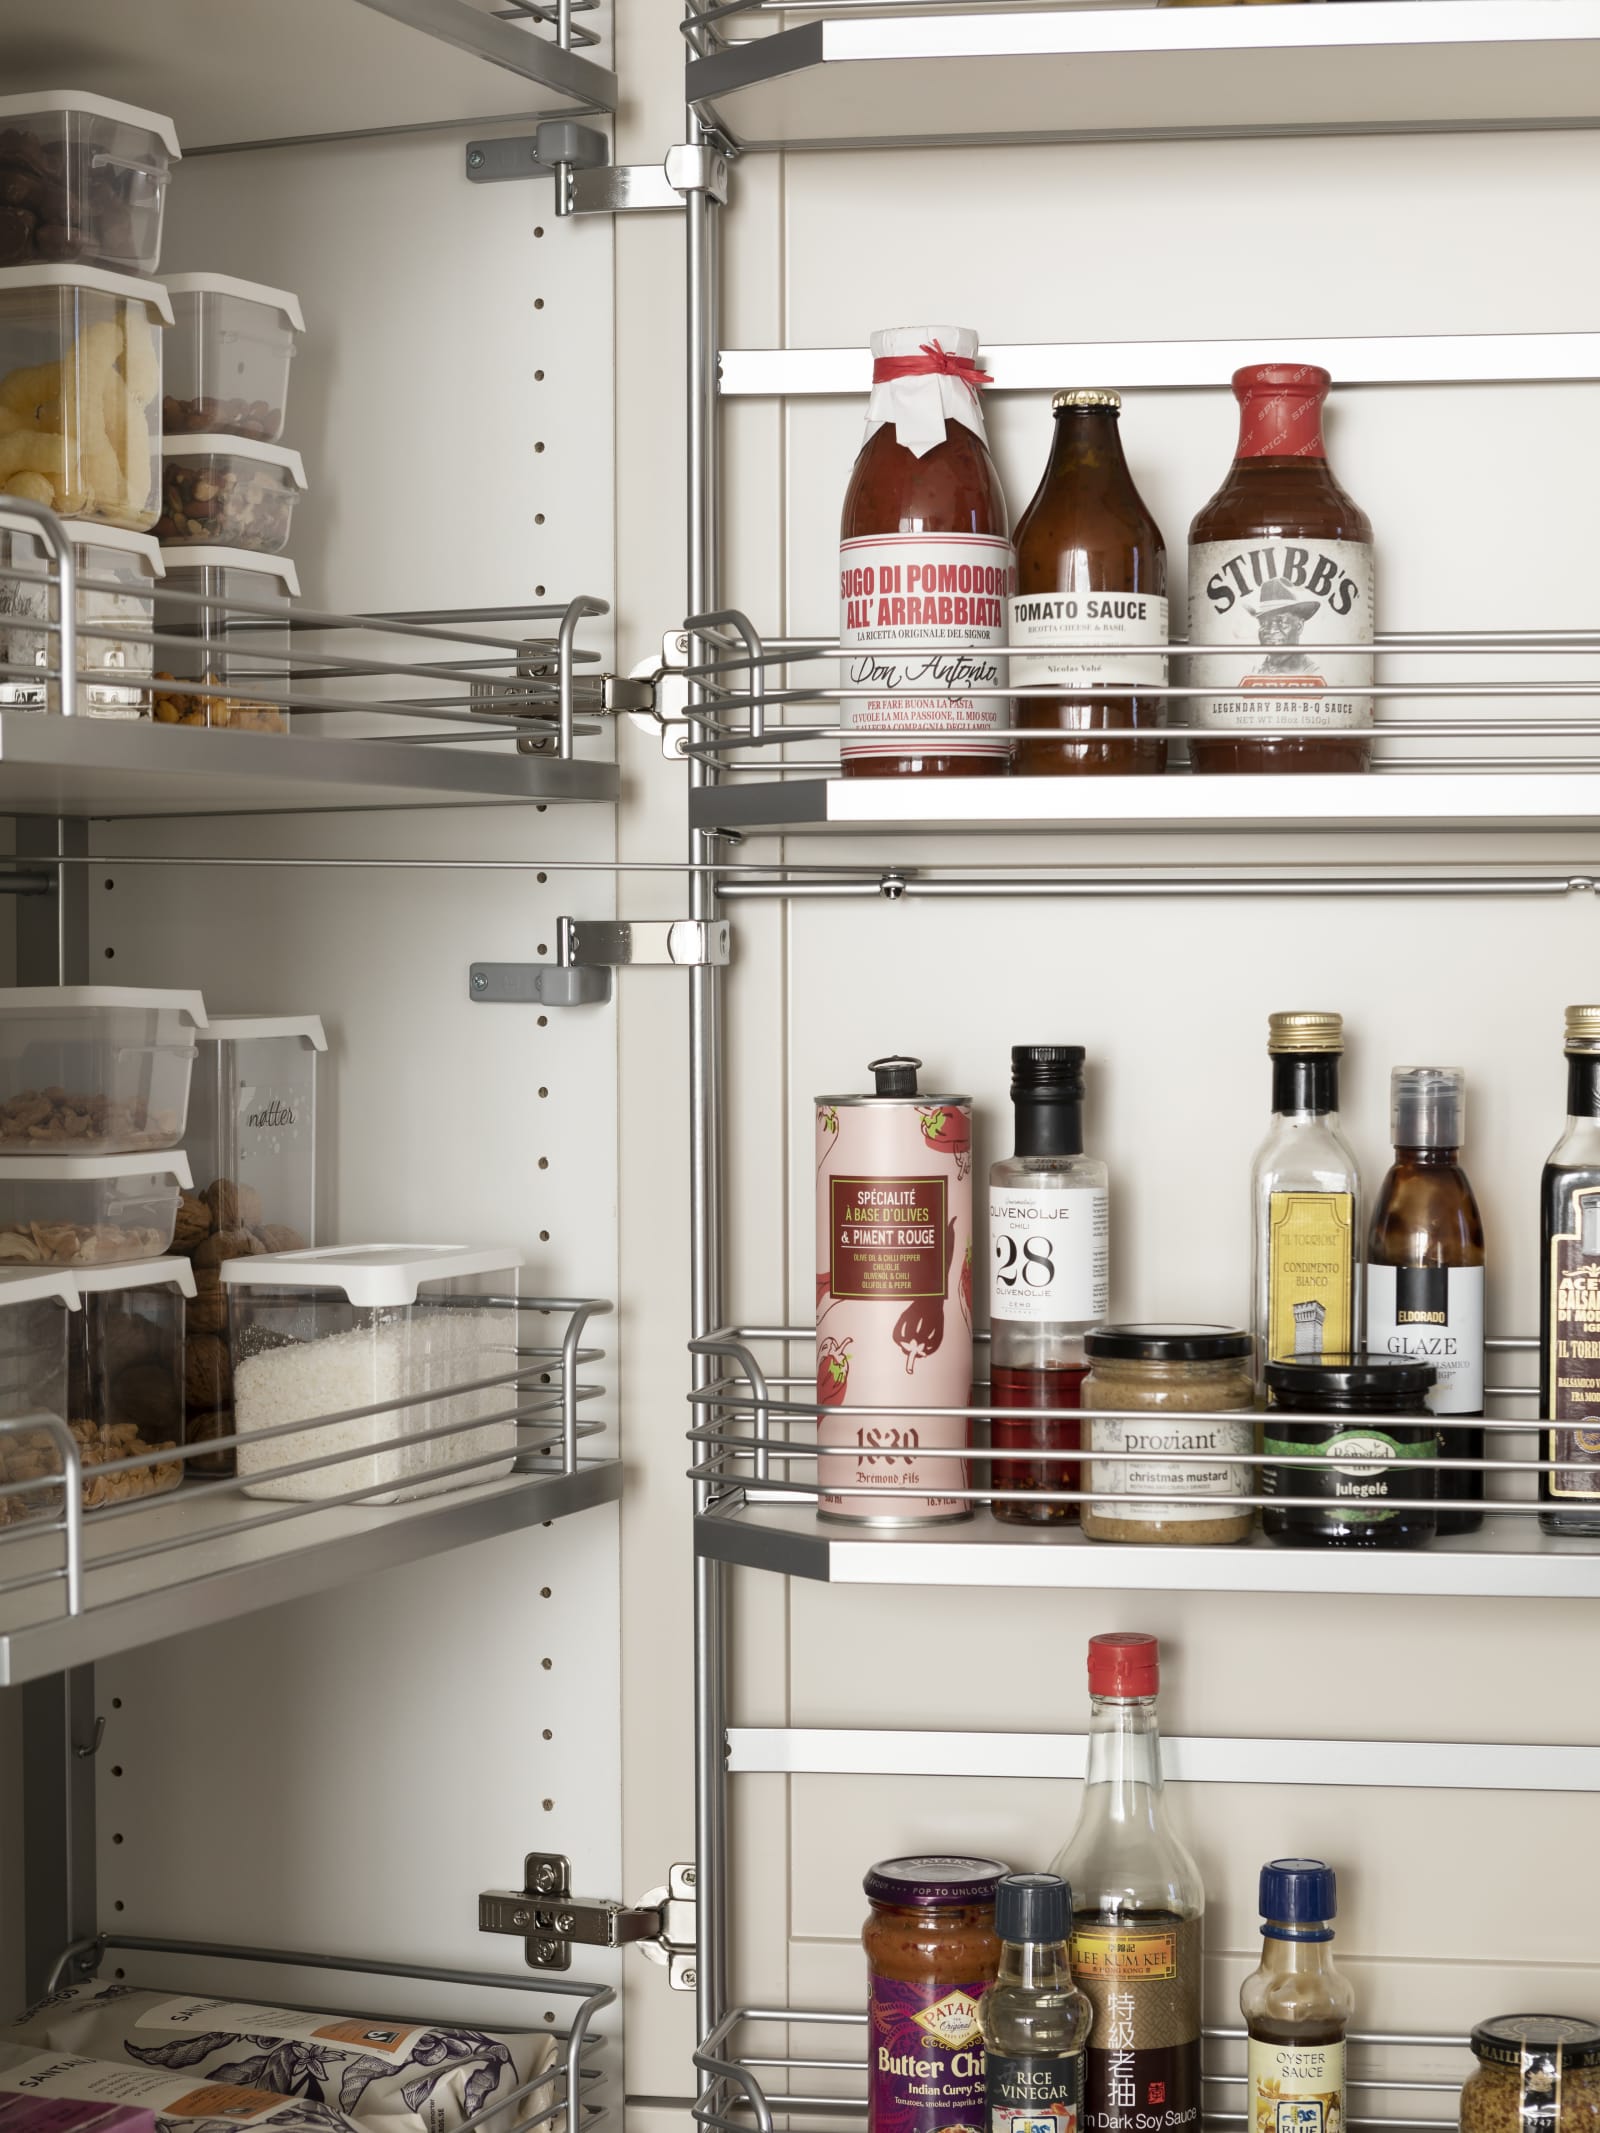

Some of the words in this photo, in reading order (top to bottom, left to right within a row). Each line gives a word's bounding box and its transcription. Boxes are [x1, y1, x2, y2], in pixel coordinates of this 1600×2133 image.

[1258, 389, 1288, 421] SPICY
[1291, 392, 1323, 421] SPICY
[841, 566, 875, 600] SUGO
[879, 564, 901, 595] DI
[906, 563, 1008, 598] POMODORO
[1206, 546, 1360, 616] STUBB'S
[847, 598, 874, 629] ALL'
[877, 596, 1002, 627] ARRABBIATA
[1014, 600, 1078, 623] TOMATO
[1086, 600, 1147, 620] SAUCE
[857, 631, 866, 641] LA
[866, 630, 897, 641] RICETTA
[898, 628, 946, 639] ORIGINALE
[947, 629, 963, 639] DEL
[964, 629, 991, 640] SIGNOR
[850, 654, 903, 688] Don
[904, 646, 998, 692] Antonio
[867, 700, 882, 710] PER
[882, 699, 904, 710] FARE
[904, 698, 936, 709] BUONA
[936, 698, 949, 709] LA
[949, 699, 974, 709] PASTA
[1213, 703, 1271, 714] LEGENDARY
[1275, 702, 1320, 713] BAR-B-Q
[1325, 703, 1353, 714] SAUCE
[858, 712, 881, 722] VUOLE
[881, 712, 892, 721] LA
[893, 711, 911, 721] MIA
[911, 711, 955, 722] PASSIONE,
[956, 711, 965, 721] IL
[966, 711, 981, 721] MIO
[1236, 716, 1254, 725] NET
[1258, 716, 1272, 724] WT
[857, 1188, 916, 1206] SPÉCIALITÉ
[845, 1205, 852, 1221] À
[854, 1207, 880, 1222] BASE
[883, 1207, 929, 1222] D'OLIVES
[1009, 1222, 1030, 1230] CHILI
[841, 1231, 850, 1244] &
[853, 1229, 894, 1246] PIMENT
[898, 1229, 935, 1245] ROUGE
[996, 1234, 1056, 1288] 28
[1283, 1262, 1340, 1274] CONDIMENTO
[1295, 1276, 1329, 1287] BIANCO
[1559, 1277, 1600, 1290] ACE
[1397, 1310, 1446, 1324] ELDORADO
[1558, 1310, 1572, 1321] DI
[1387, 1336, 1457, 1355] GLAZE
[1558, 1340, 1569, 1358] IL
[1430, 1360, 1471, 1369] ALSAMICO
[1124, 1429, 1217, 1453] proviant
[1129, 1471, 1184, 1483] christmas
[1186, 1470, 1229, 1482] mustard
[1335, 1481, 1389, 1497] Julegelé
[913, 1887, 931, 1896] POP
[936, 1888, 949, 1896] TO
[952, 1886, 989, 1896] UNLOCK
[1076, 1951, 1099, 1965] LEE
[1104, 1953, 1140, 1967] KUM
[1143, 1952, 1168, 1966] KEE
[923, 2002, 977, 2028] PATAK
[1107, 1991, 1136, 2107] 特級老抽
[1480, 2044, 1521, 2064] MAILL
[878, 2047, 945, 2079] Butter
[951, 2050, 985, 2078] Chi
[1276, 2052, 1326, 2065] OYSTER
[1016, 2071, 1053, 2085] RICE
[1281, 2066, 1324, 2078] SAUCE
[908, 2082, 940, 2096] Indian
[942, 2083, 972, 2096] Curry
[974, 2081, 985, 2093] Sa
[1001, 2083, 1069, 2100] VINEGAR
[894, 2096, 925, 2107] Tomatoes,
[925, 2100, 951, 2108] smoked
[952, 2099, 976, 2109] paprika
[1098, 2112, 1135, 2129] Dark
[1135, 2113, 1164, 2131] Soy
[1165, 2107, 1198, 2127] Sauce
